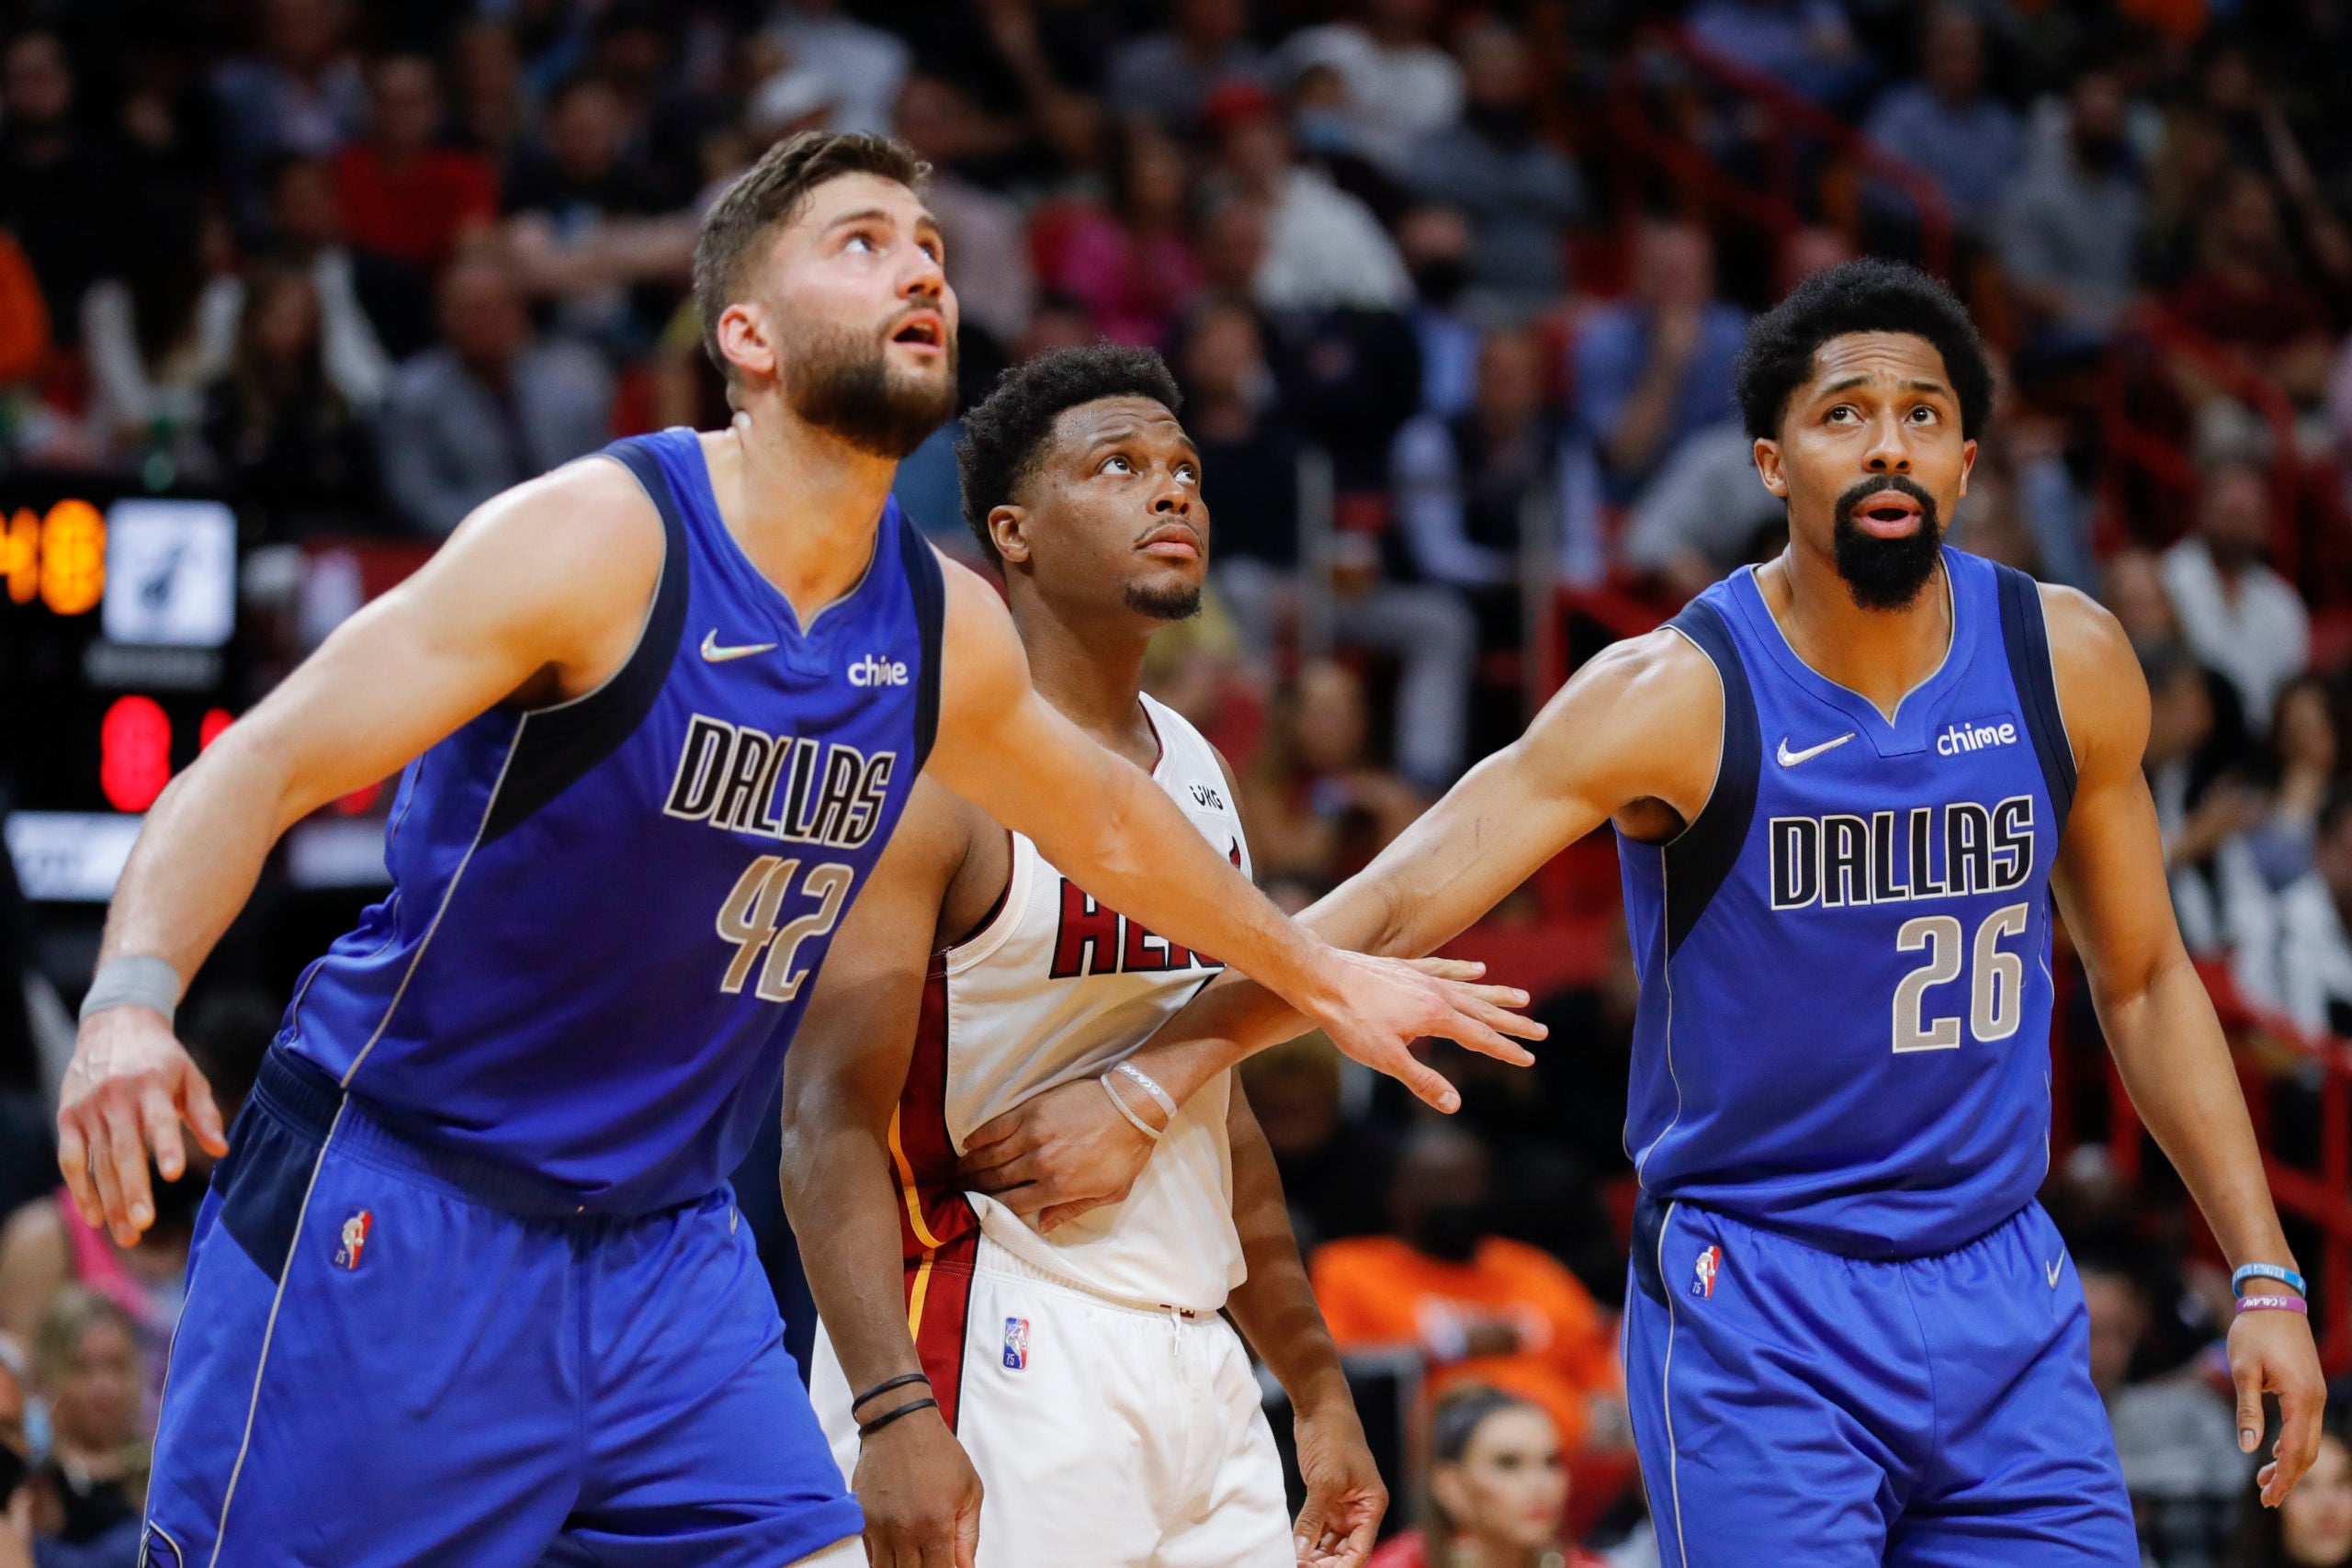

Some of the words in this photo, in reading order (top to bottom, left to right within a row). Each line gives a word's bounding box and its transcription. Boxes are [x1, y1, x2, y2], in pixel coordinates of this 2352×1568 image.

[663, 713, 897, 850] DALLAS
[1936, 722, 2018, 756] chime
[1769, 794, 2035, 911] DALLAS
[716, 855, 854, 1002] 42
[1048, 876, 1228, 979] HE
[1892, 902, 2030, 1054] 26
[1692, 1281, 1702, 1294] 75
[1006, 1353, 1015, 1366] 75
